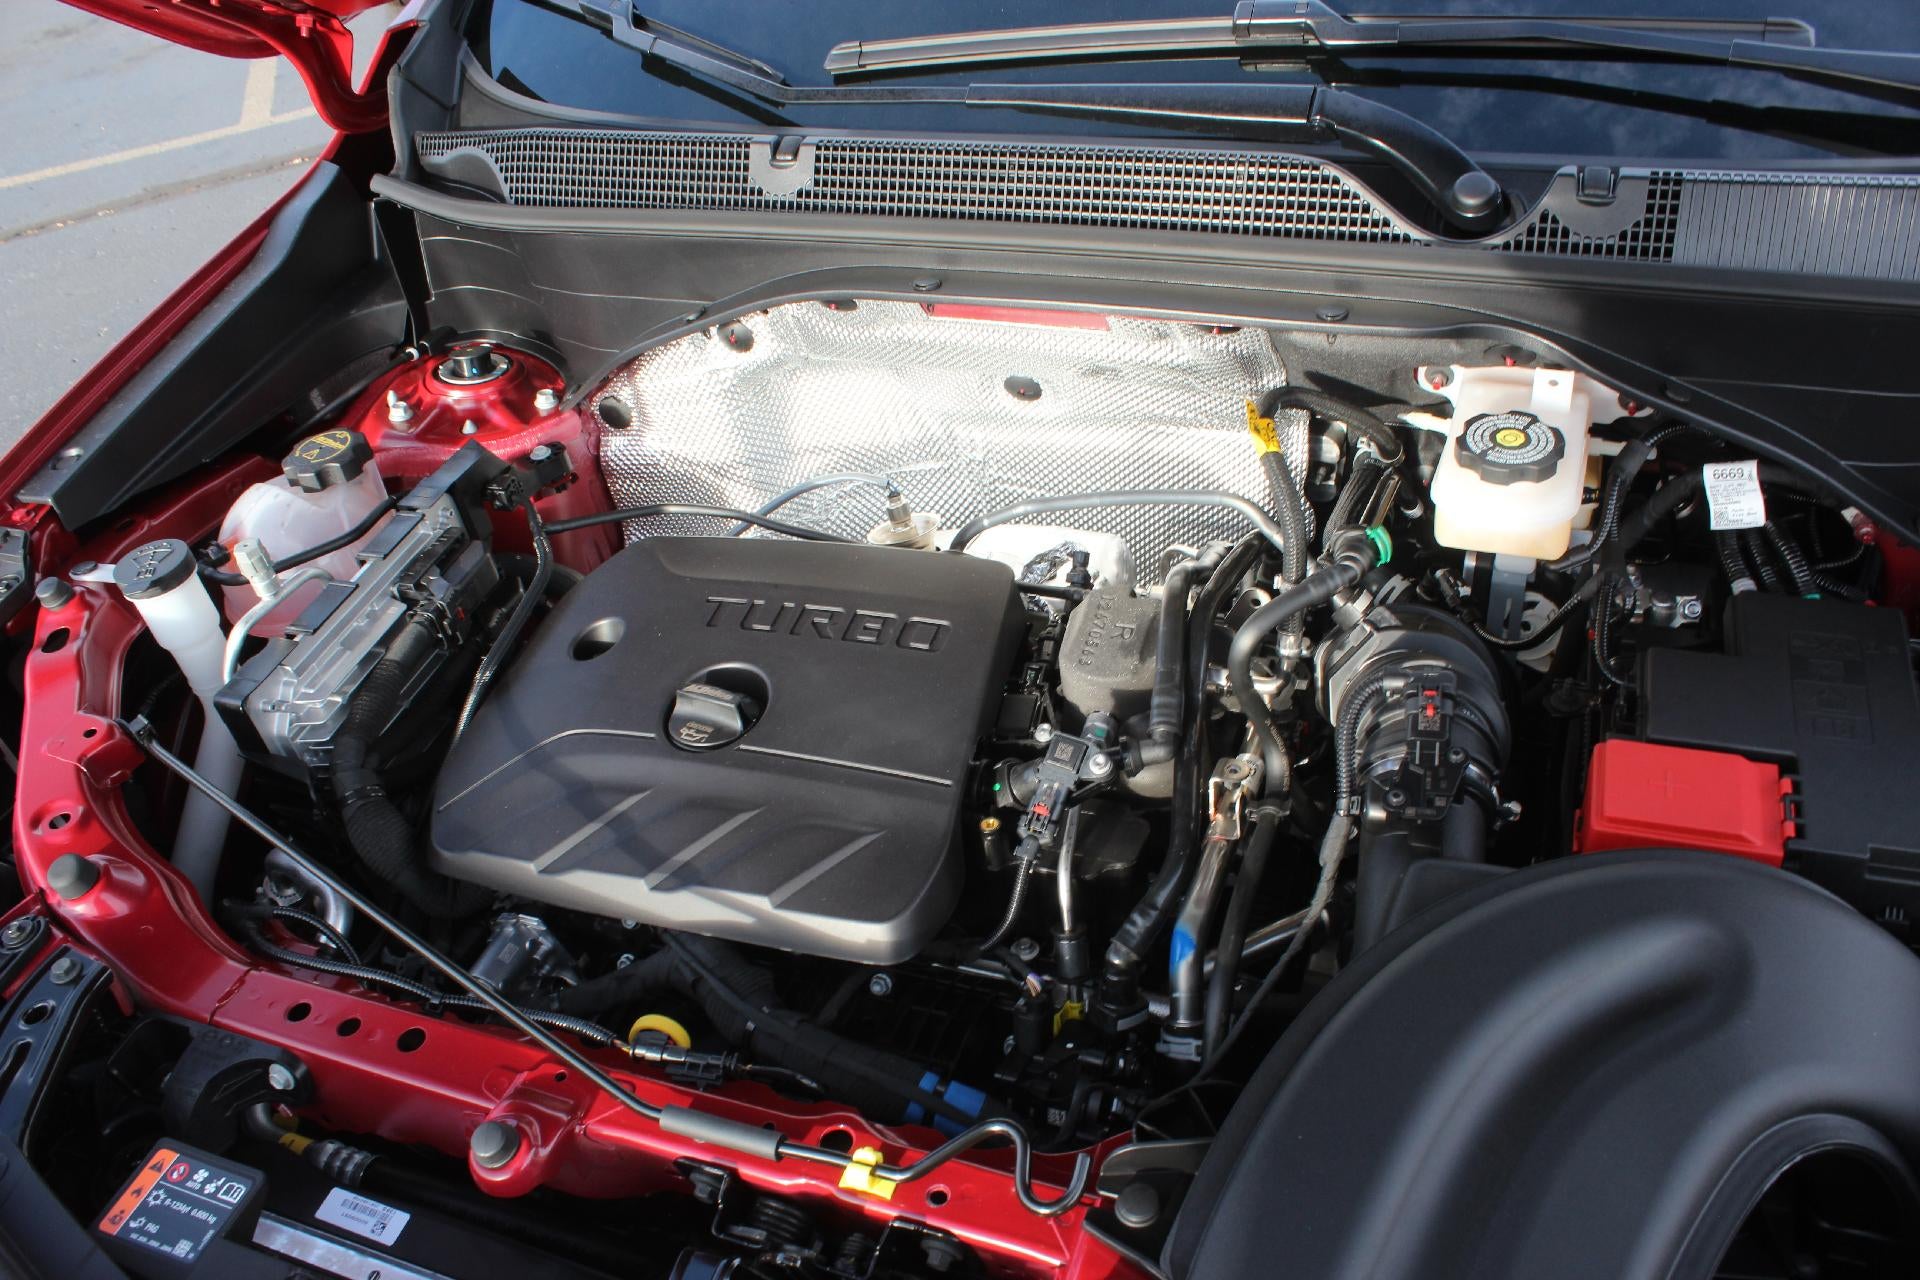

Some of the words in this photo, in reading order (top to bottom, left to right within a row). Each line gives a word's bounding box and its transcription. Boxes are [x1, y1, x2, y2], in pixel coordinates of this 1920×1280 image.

[1712, 467, 1744, 480] 6669
[706, 596, 952, 653] TURBO
[1110, 622, 1137, 641] R
[143, 1219, 160, 1234] PAG
